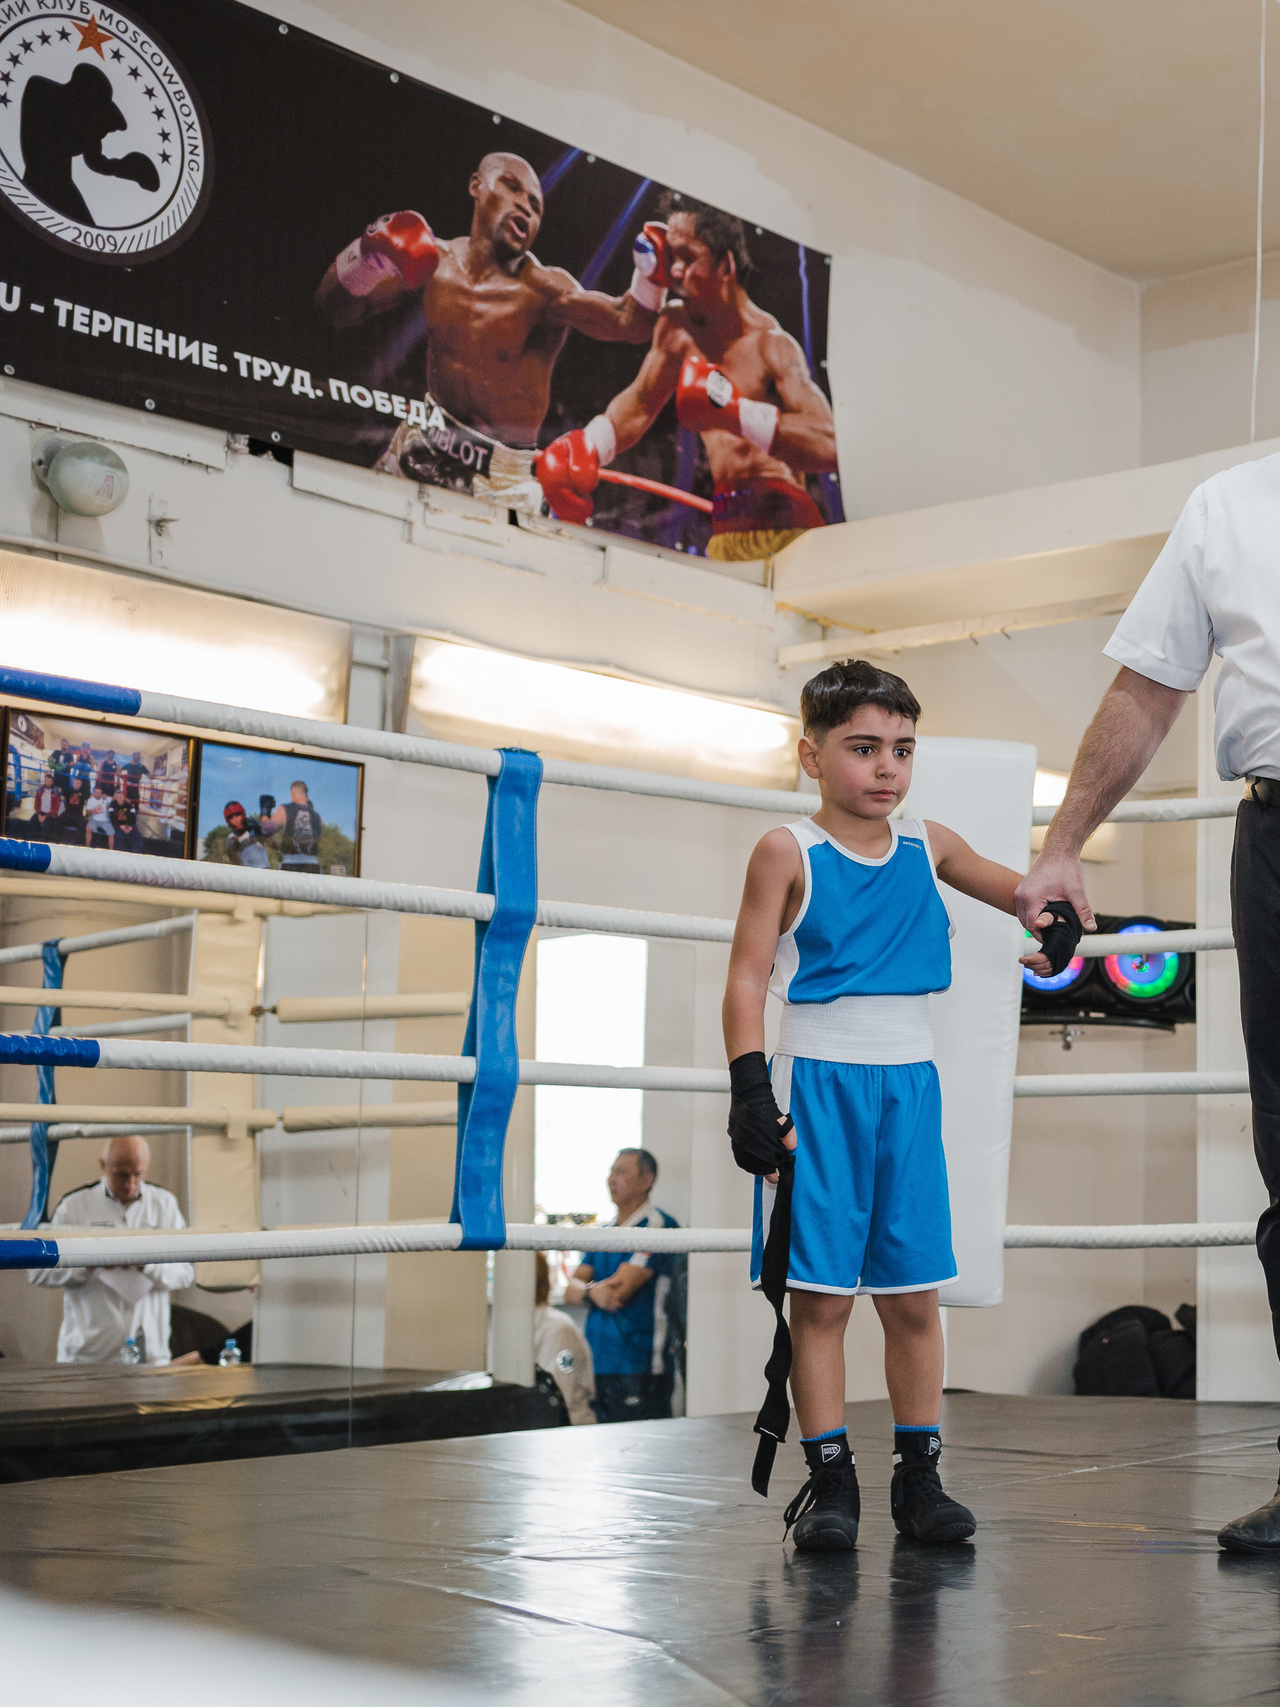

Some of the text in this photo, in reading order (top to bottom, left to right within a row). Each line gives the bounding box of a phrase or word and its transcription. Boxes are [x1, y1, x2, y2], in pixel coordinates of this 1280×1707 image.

[37, 0, 90, 15] КЛУБ
[70, 227, 118, 253] 2009
[53, 298, 229, 373] ТЕРПЕНИЕ.
[233, 351, 324, 399] ТРУД.
[328, 377, 446, 432] ПОБЕДА
